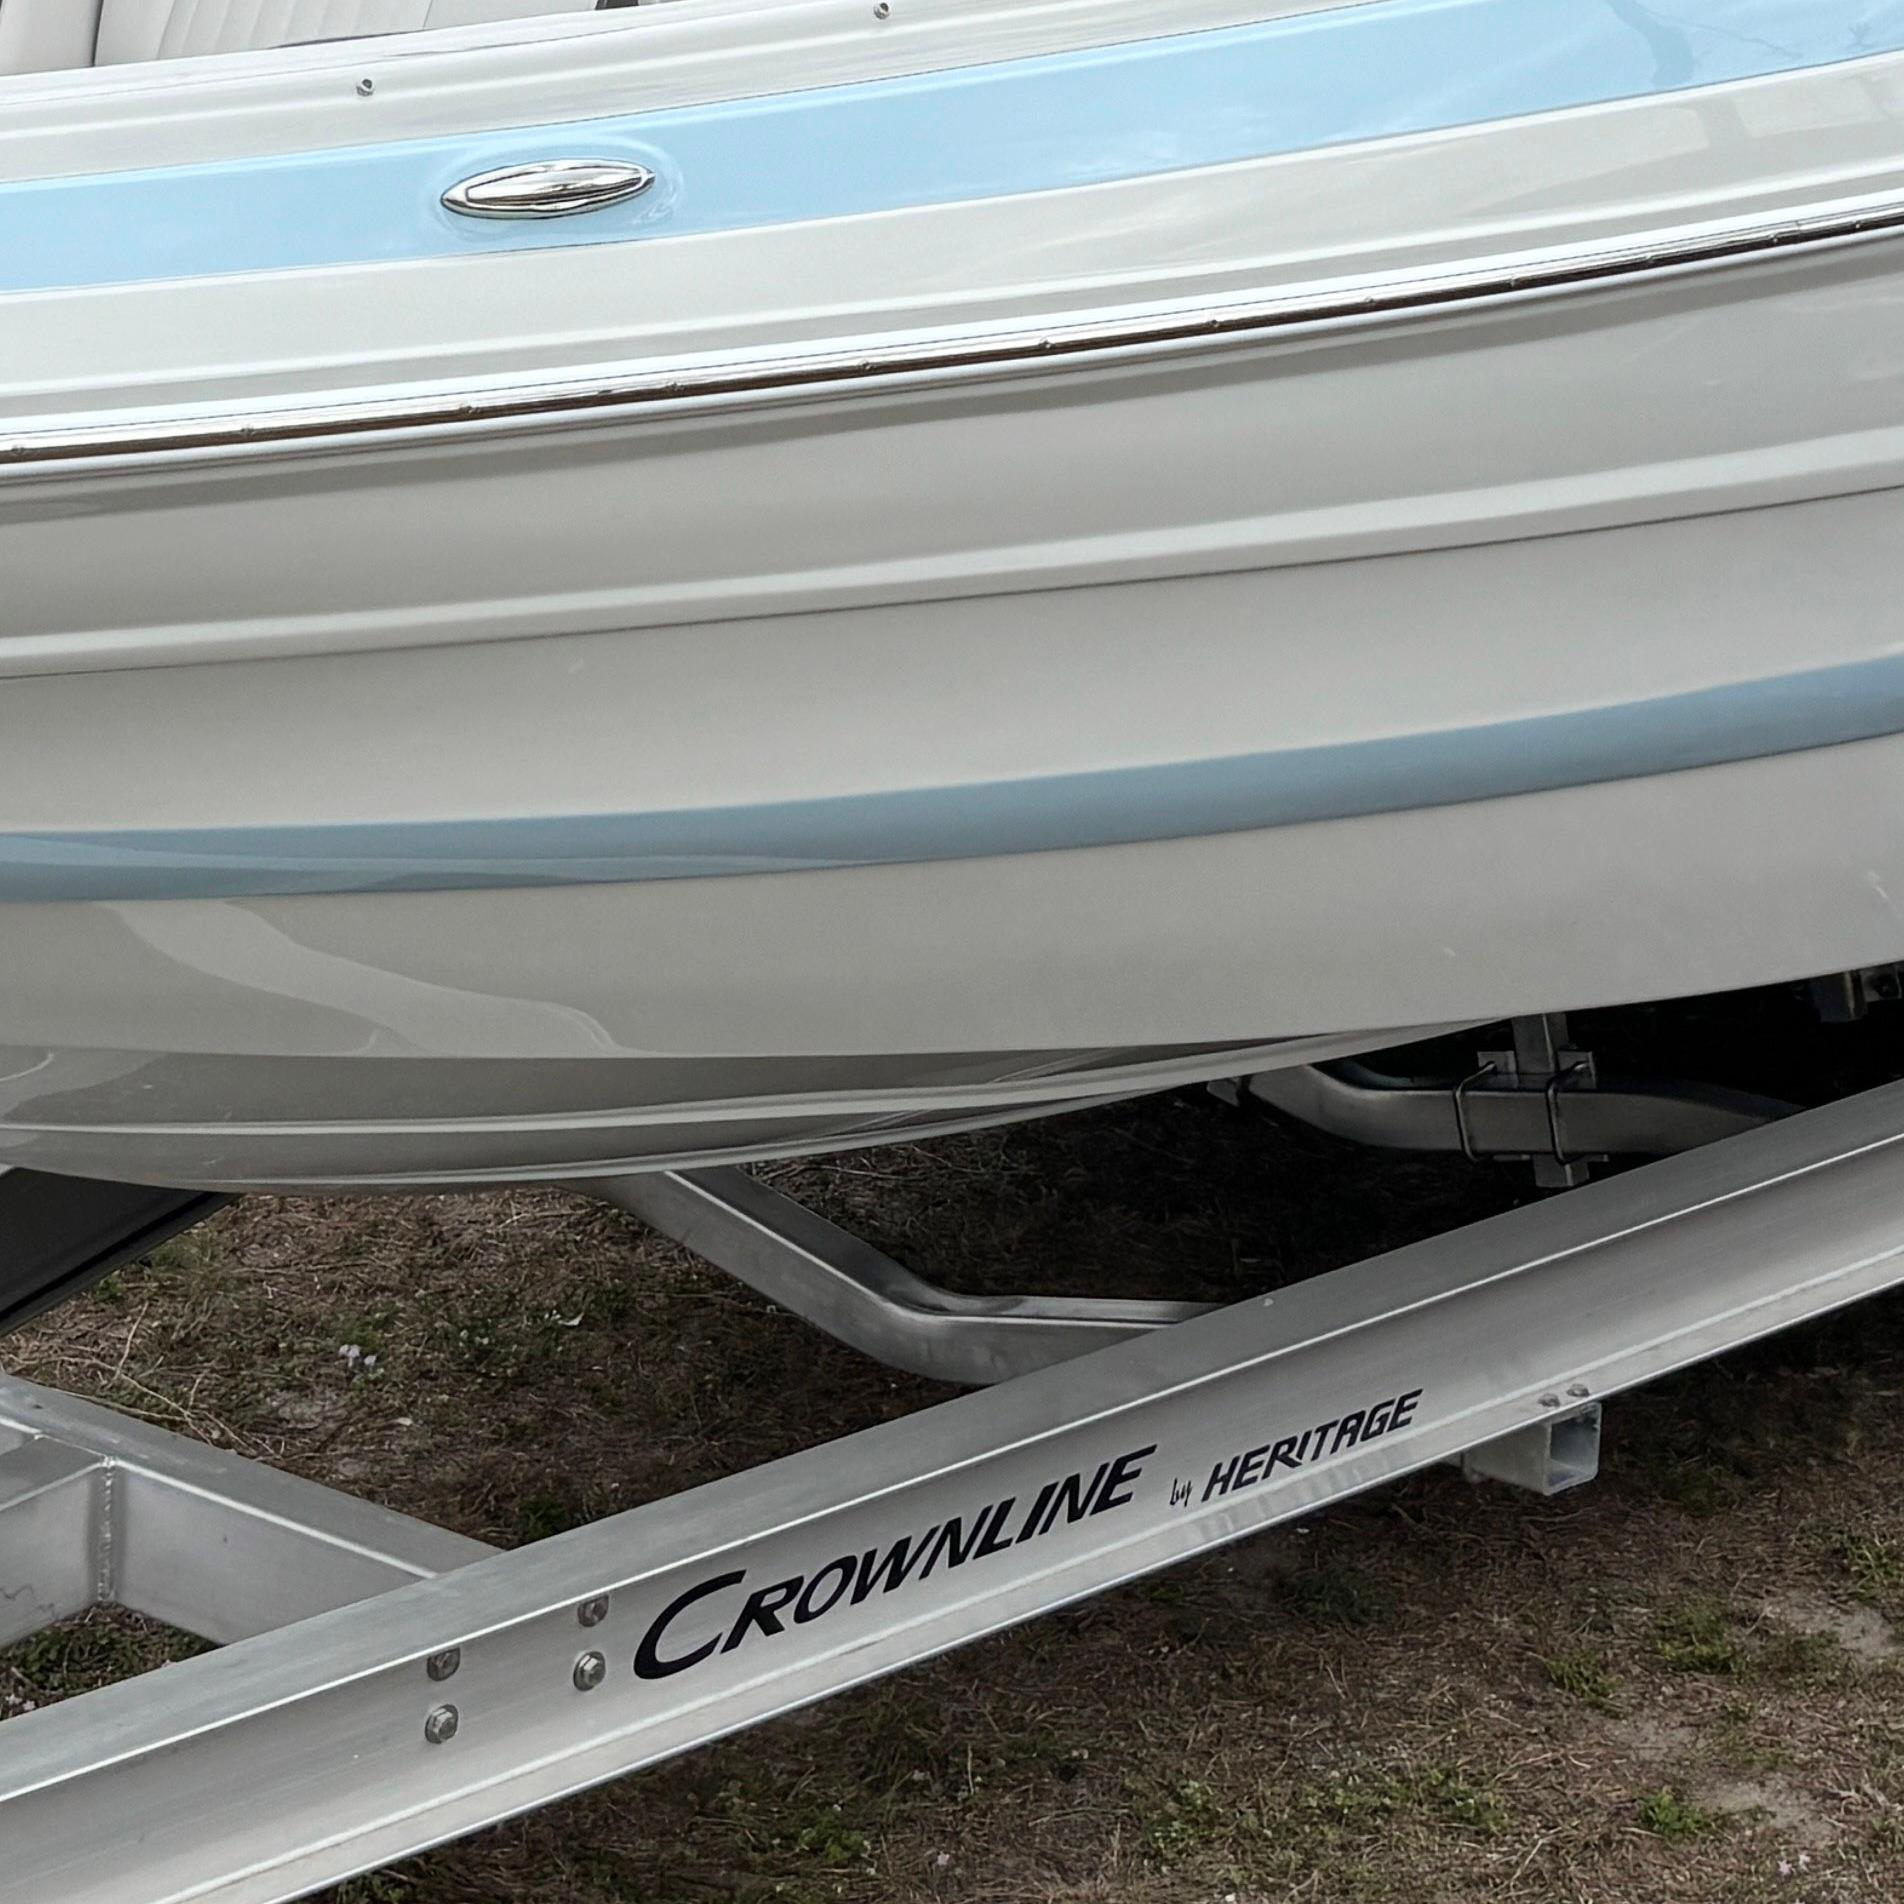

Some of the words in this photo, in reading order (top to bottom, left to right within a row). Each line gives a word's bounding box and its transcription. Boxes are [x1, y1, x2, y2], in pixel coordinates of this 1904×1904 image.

[633, 1444, 1158, 1680] CROWNLINE
[1170, 1476, 1193, 1508] by
[1201, 1388, 1424, 1502] HERITAGE
